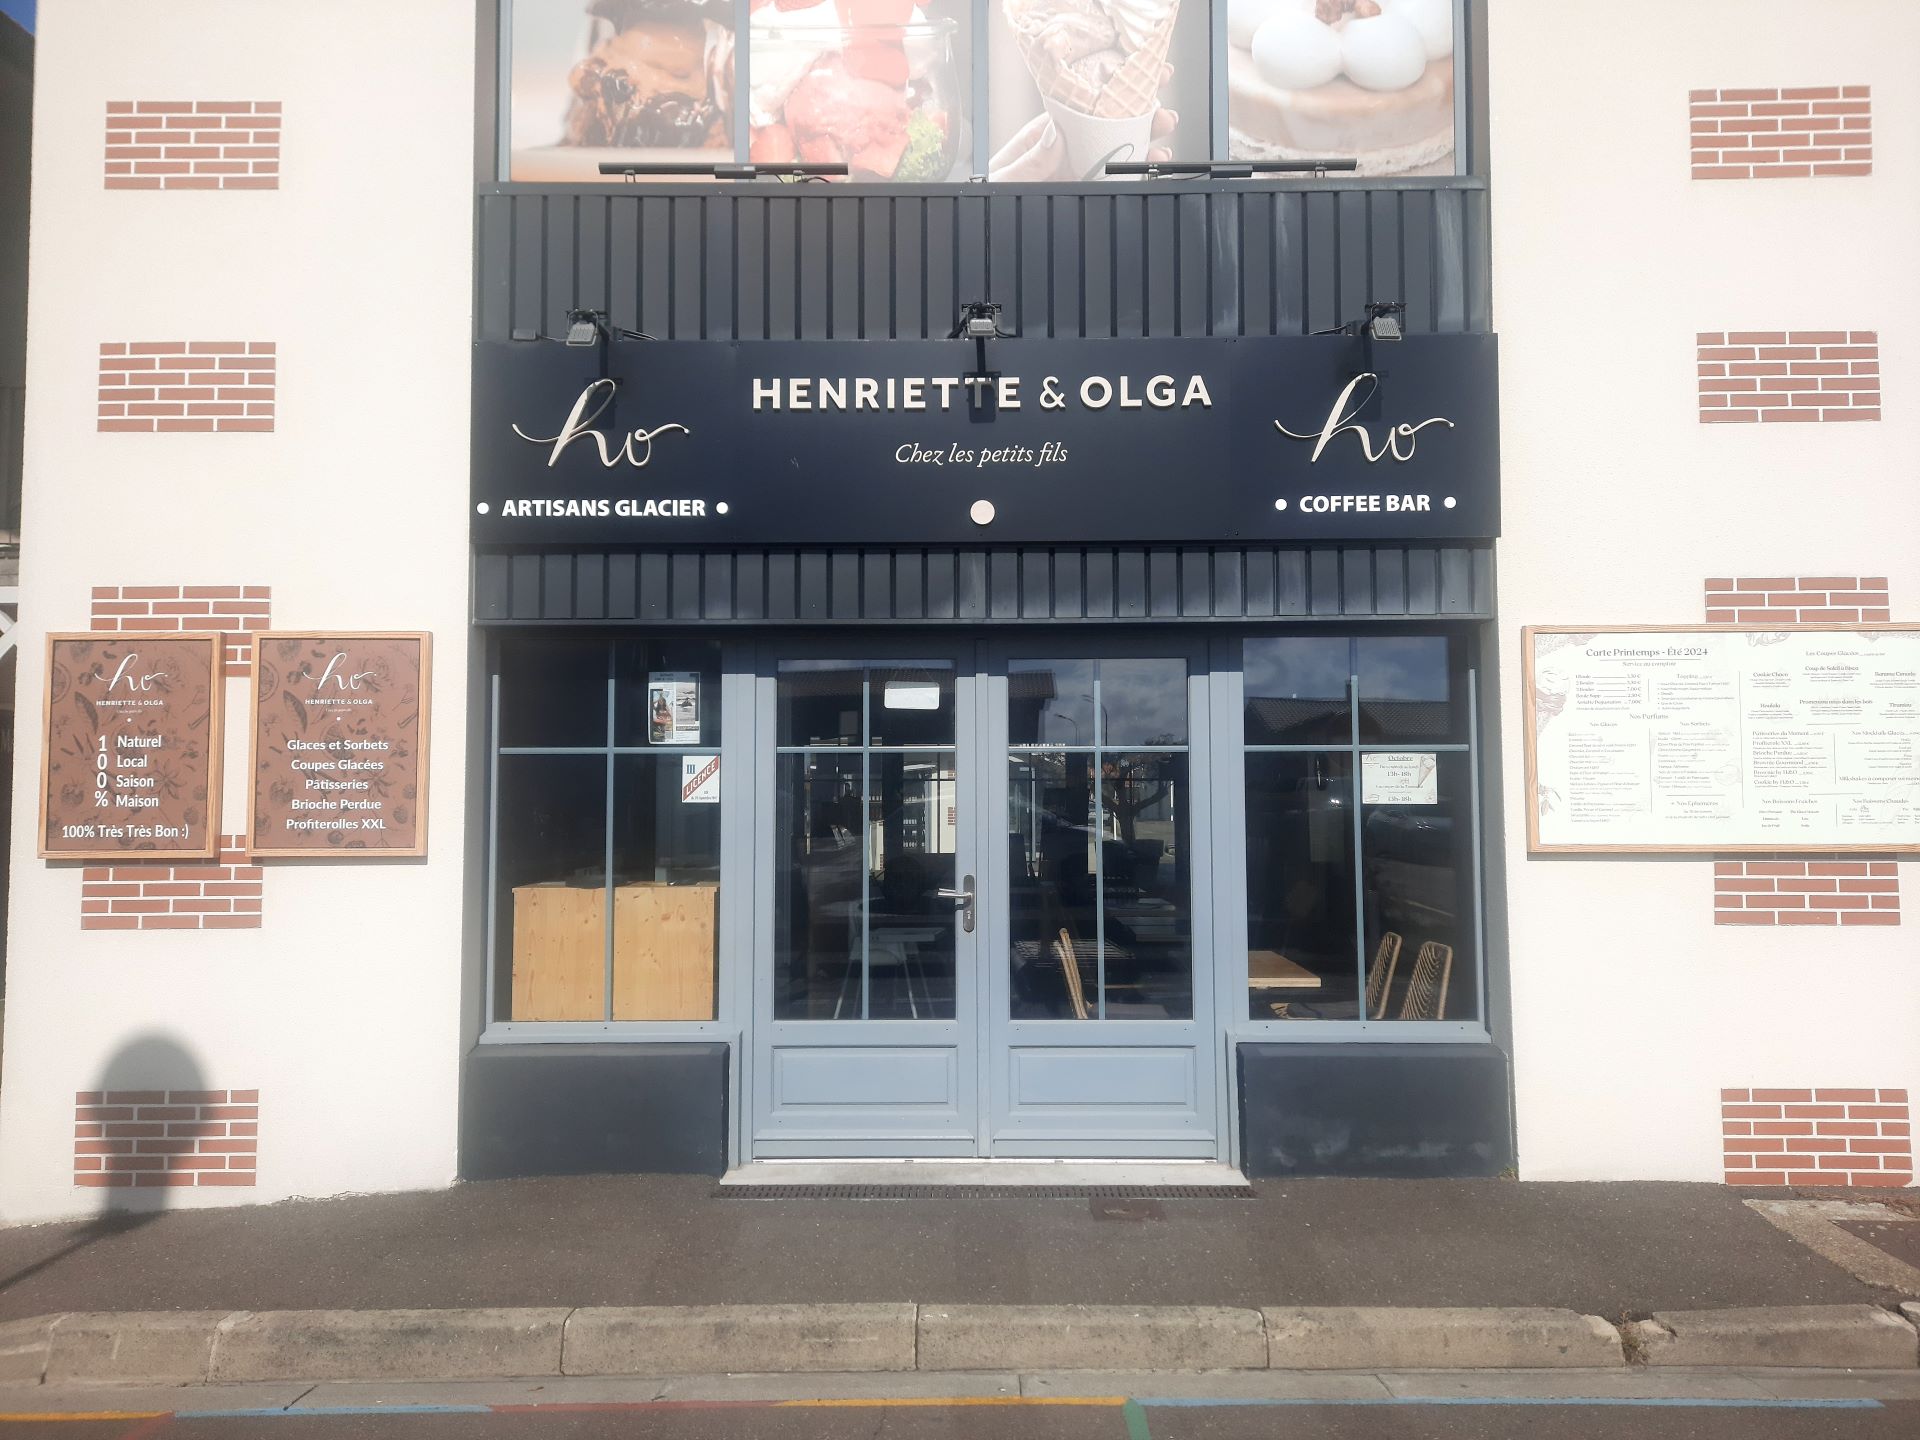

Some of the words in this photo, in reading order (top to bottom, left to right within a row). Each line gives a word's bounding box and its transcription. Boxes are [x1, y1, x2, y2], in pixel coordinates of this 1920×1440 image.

[753, 377, 1021, 411] HENRIETTE
[1039, 375, 1066, 409] &
[1079, 374, 1212, 408] OLGA
[895, 442, 944, 466] Chez
[948, 442, 974, 464] les
[976, 444, 1034, 468] petits
[1034, 441, 1068, 467] fils
[501, 499, 610, 517] ARTISANS
[614, 498, 706, 517] GLACIER
[1299, 495, 1381, 513] COFFEE
[1386, 494, 1431, 512] BAR
[1586, 648, 1612, 656] Carte
[1613, 648, 1660, 658] Printemps
[1667, 646, 1682, 656] Été
[1684, 648, 1708, 656] 2024
[117, 735, 162, 748] Naturel
[287, 740, 326, 750] Glaces
[328, 740, 342, 750] et
[344, 740, 388, 750] Sorbets
[116, 754, 148, 768] Local
[291, 760, 336, 771] Coupes
[338, 759, 384, 770] Glacées
[116, 774, 154, 788] Saison
[305, 779, 368, 790] Pâtisseries
[686, 760, 716, 796] LICENCE
[116, 794, 159, 807] Maison
[292, 799, 337, 810] Brioche
[340, 799, 382, 810] Perdue
[286, 818, 358, 830] Profiterolles
[361, 818, 386, 829] XXL
[62, 825, 95, 838] 100%
[98, 824, 124, 838] Très
[126, 824, 152, 838] Très
[155, 824, 178, 837] Bon
